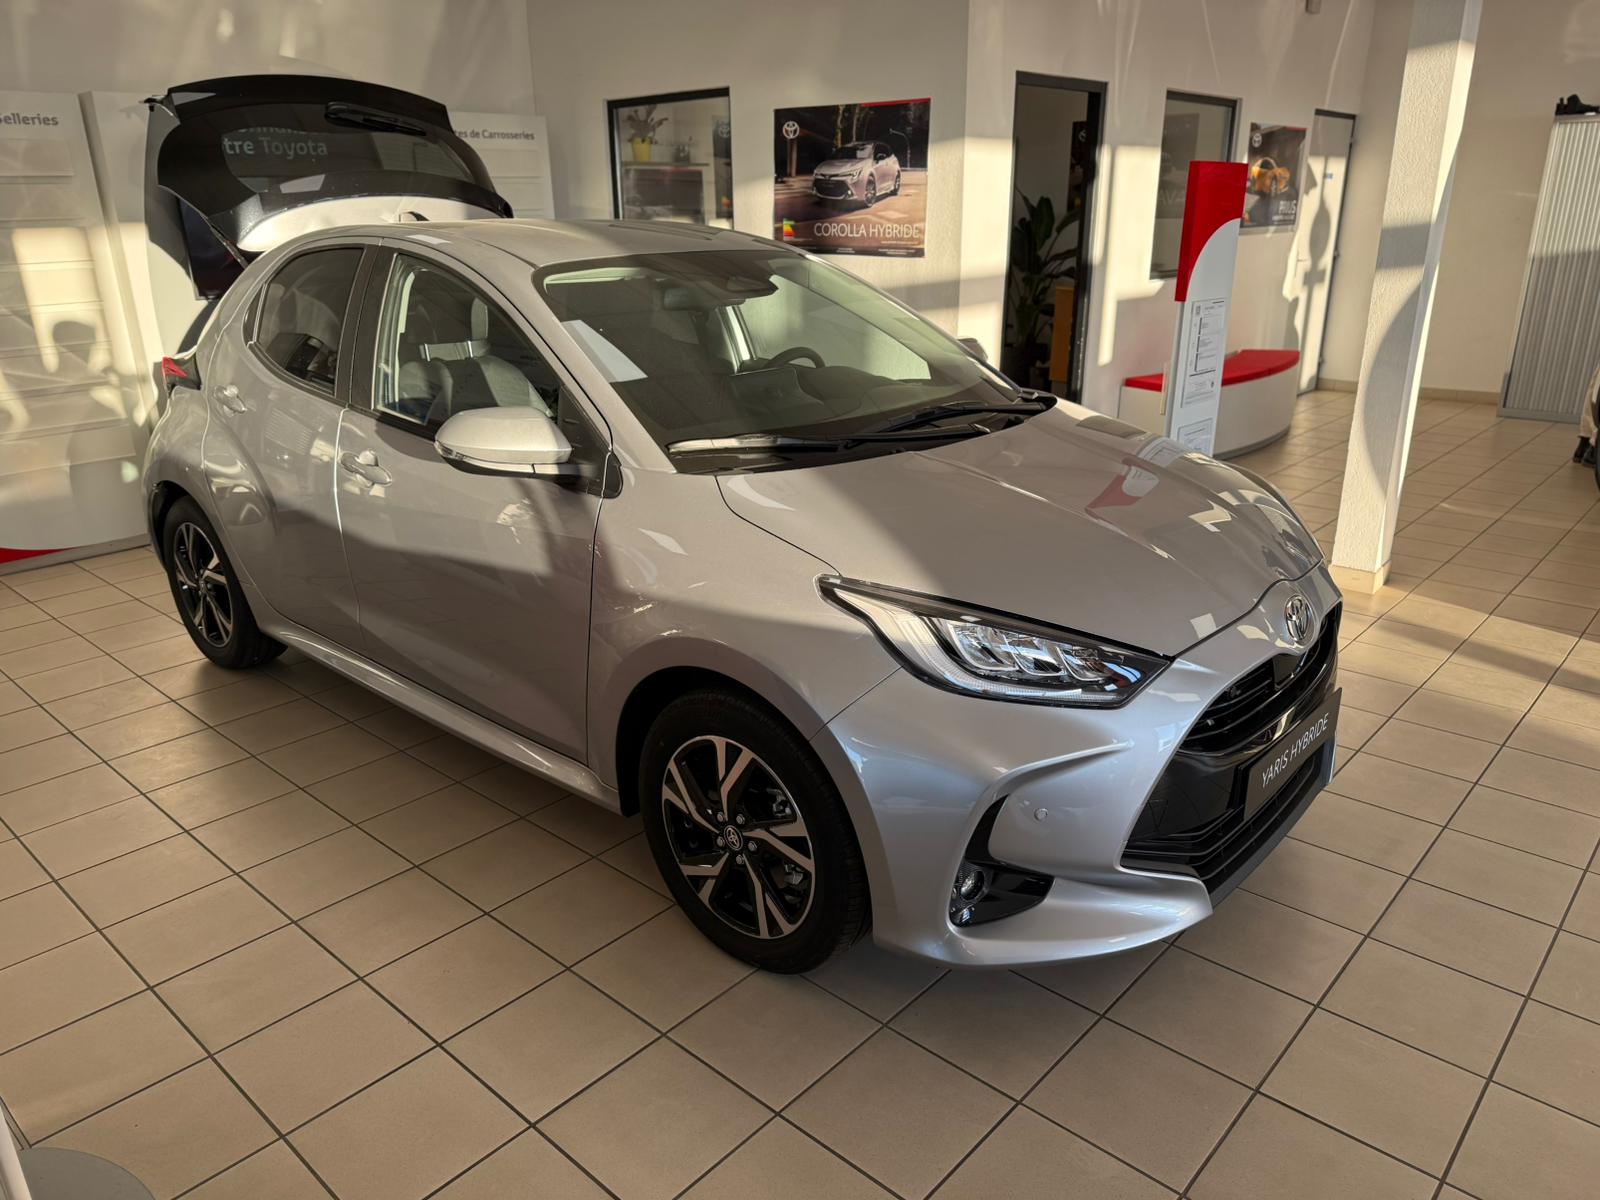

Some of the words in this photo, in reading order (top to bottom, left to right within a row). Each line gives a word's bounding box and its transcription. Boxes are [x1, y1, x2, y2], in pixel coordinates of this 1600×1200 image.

[469, 129, 480, 139] de
[481, 129, 535, 140] Carrosseries
[258, 137, 328, 160] Toyota
[814, 223, 867, 237] COROLLA
[869, 223, 920, 238] HYBRIDE
[1262, 749, 1289, 789] YARIS
[1289, 712, 1329, 761] HYBRIDE
